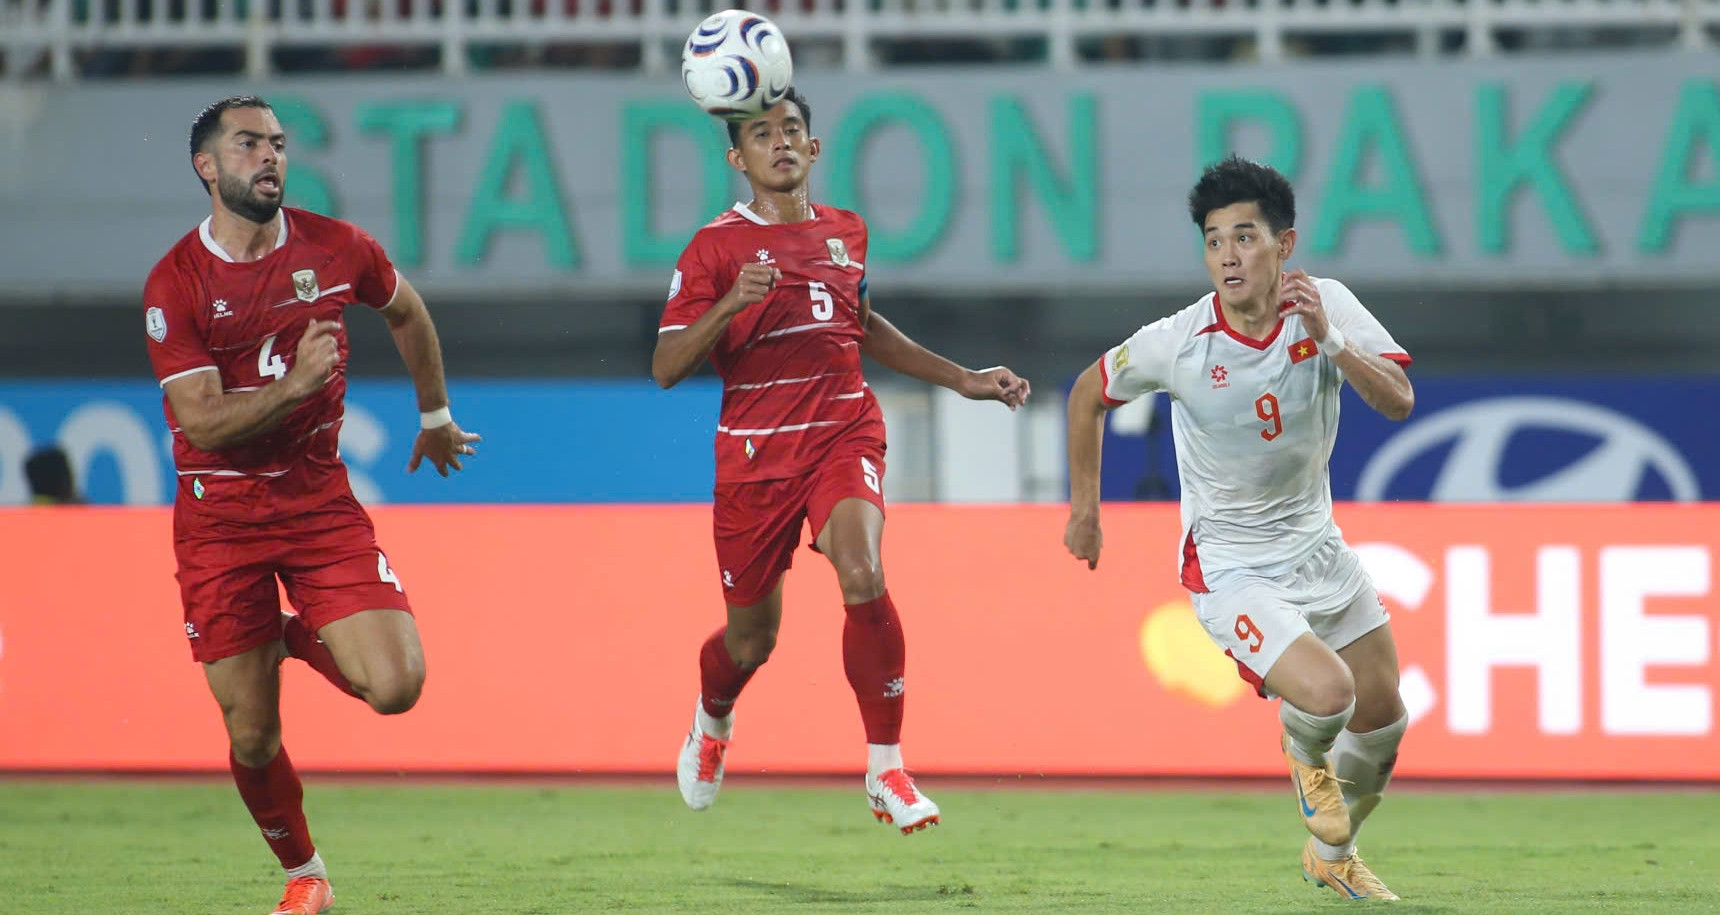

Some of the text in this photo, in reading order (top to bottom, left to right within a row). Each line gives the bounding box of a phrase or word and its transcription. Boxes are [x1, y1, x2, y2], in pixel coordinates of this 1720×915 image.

[268, 89, 1100, 269] TADON
[808, 281, 834, 321] 5
[258, 335, 287, 381] 4
[1255, 392, 1283, 441] 9
[861, 456, 881, 495] 5
[377, 551, 403, 593] 4
[1233, 614, 1264, 653] 9
